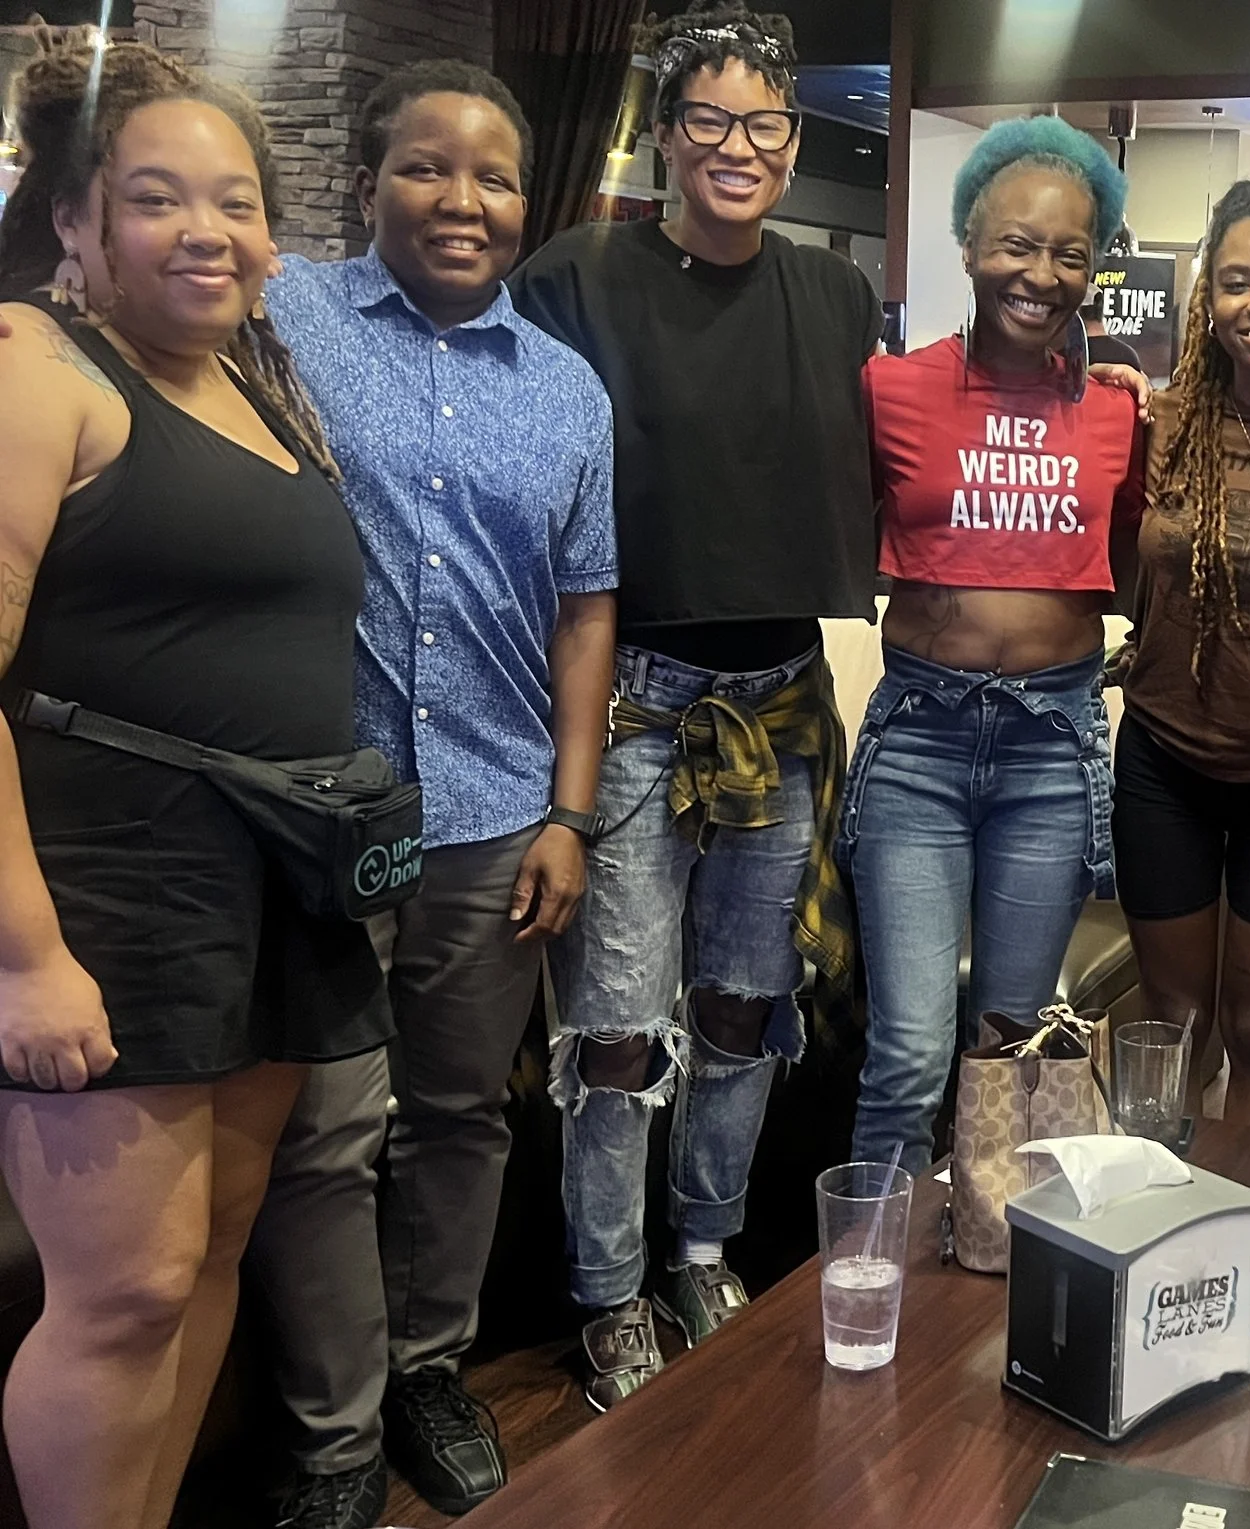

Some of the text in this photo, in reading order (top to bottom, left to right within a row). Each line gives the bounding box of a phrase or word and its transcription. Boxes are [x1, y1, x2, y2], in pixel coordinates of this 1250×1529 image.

[1094, 271, 1126, 286] NEW!
[1120, 288, 1166, 319] TIME
[986, 414, 1048, 449] ME?
[958, 448, 1079, 488] WEIRD?
[950, 489, 1086, 535] ALWAYS.
[1157, 1275, 1230, 1310] GAMES
[1157, 1297, 1227, 1325] LANES
[1151, 1314, 1224, 1346] Food & Fun
